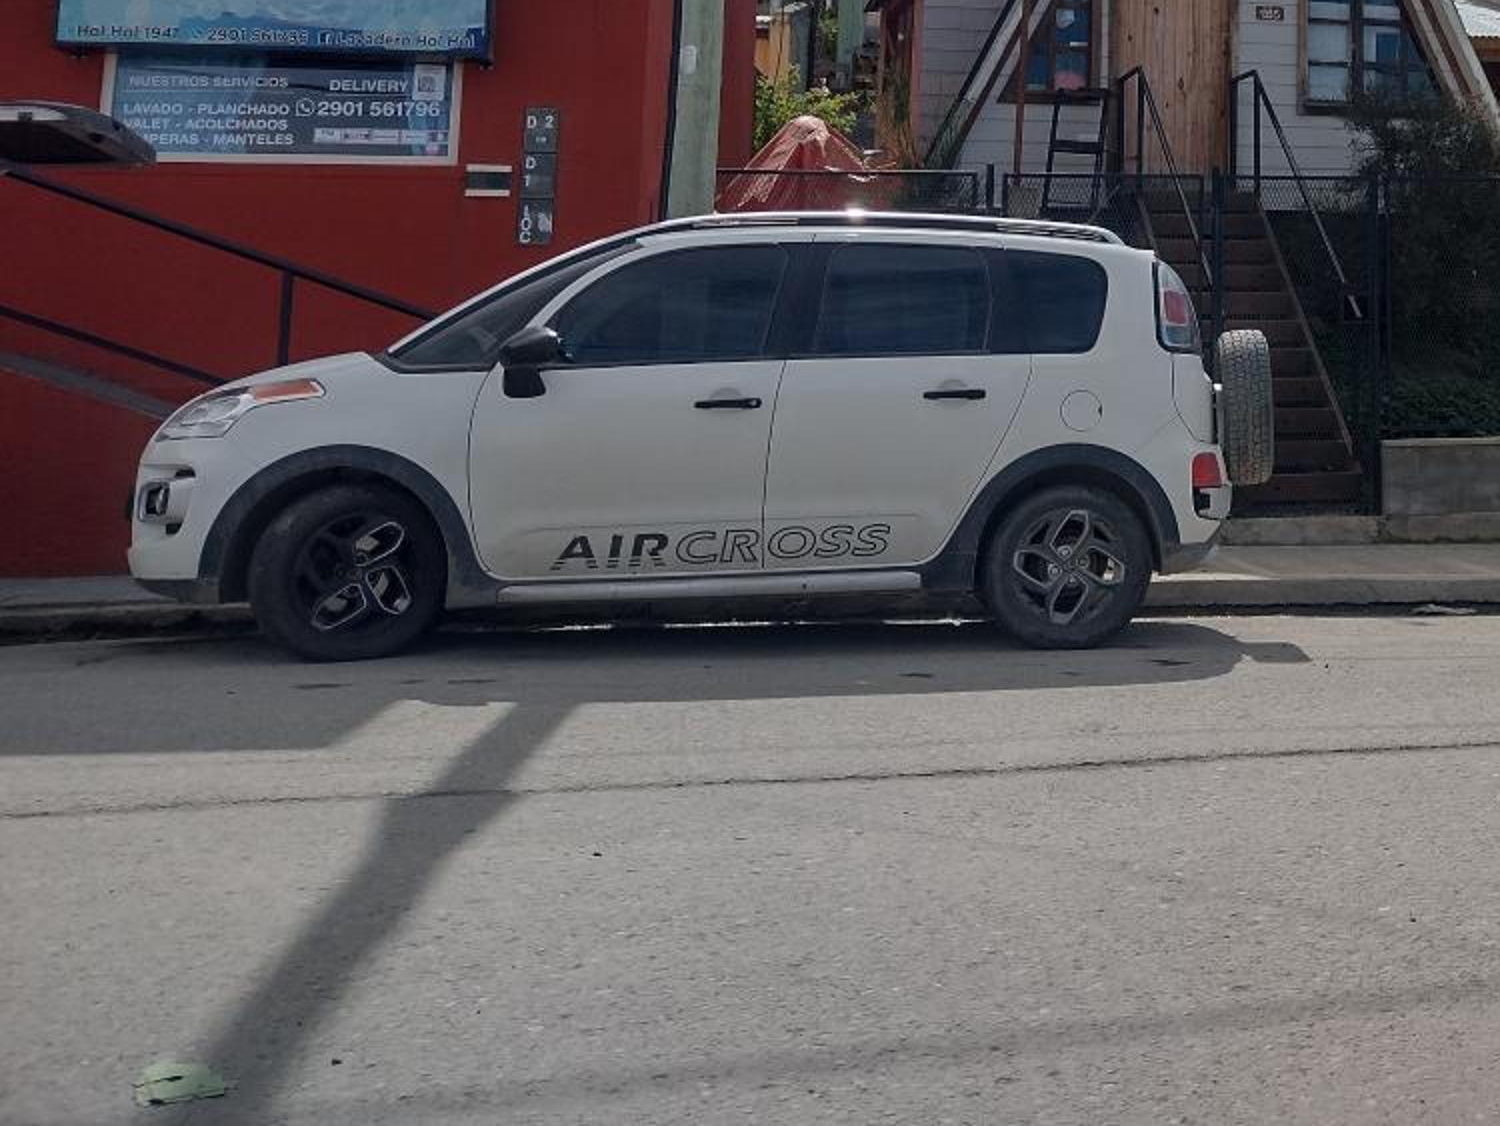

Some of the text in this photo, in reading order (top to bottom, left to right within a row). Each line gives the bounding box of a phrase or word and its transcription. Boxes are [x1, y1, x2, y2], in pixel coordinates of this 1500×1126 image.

[129, 75, 289, 89] NUESTROS SERVICIOS
[329, 79, 408, 92] DELIVERY
[124, 103, 183, 115] LAVADO
[197, 103, 290, 116] PLANCHADO
[318, 101, 440, 117] 2901 561796
[124, 119, 171, 130] VALET
[187, 119, 288, 131] ACOLCHADOS
[212, 133, 294, 146] MANTELES
[550, 524, 891, 570] AIRCROSS
